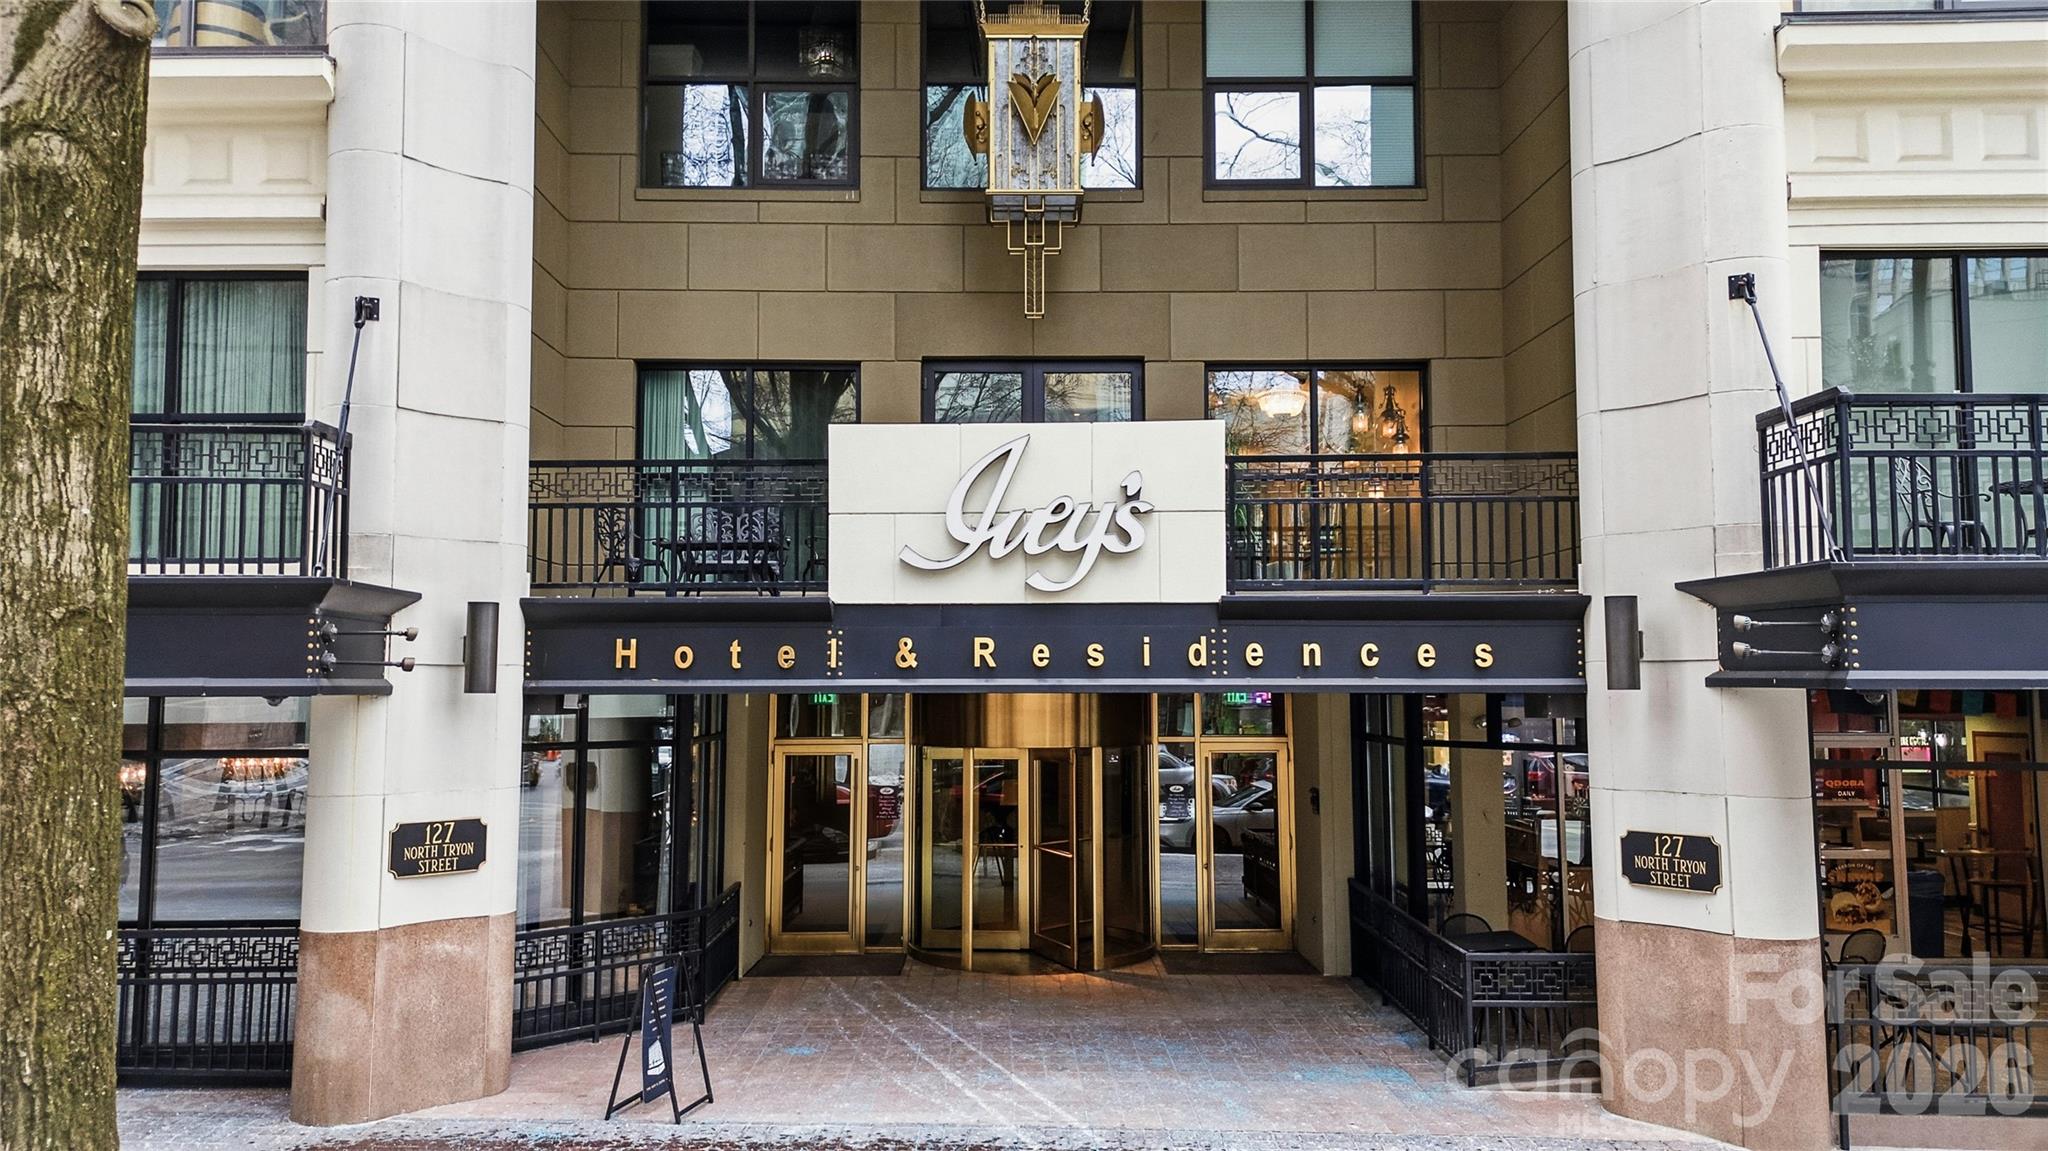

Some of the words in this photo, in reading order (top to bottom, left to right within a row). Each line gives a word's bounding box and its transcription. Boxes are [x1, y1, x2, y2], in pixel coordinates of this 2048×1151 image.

[899, 433, 1154, 592] Ivey's
[615, 638, 837, 669] Hotel
[895, 637, 918, 669] &
[973, 636, 1494, 668] Residences
[1825, 779, 1865, 788] QDOBA
[425, 821, 455, 845] 127
[404, 845, 438, 861] NORTH
[443, 842, 474, 857] TRYON
[1654, 835, 1683, 857] 127
[418, 857, 459, 873] STREET
[1634, 855, 1669, 870] NORTH
[1672, 858, 1707, 875] TRYON
[1650, 871, 1691, 888] STREET
